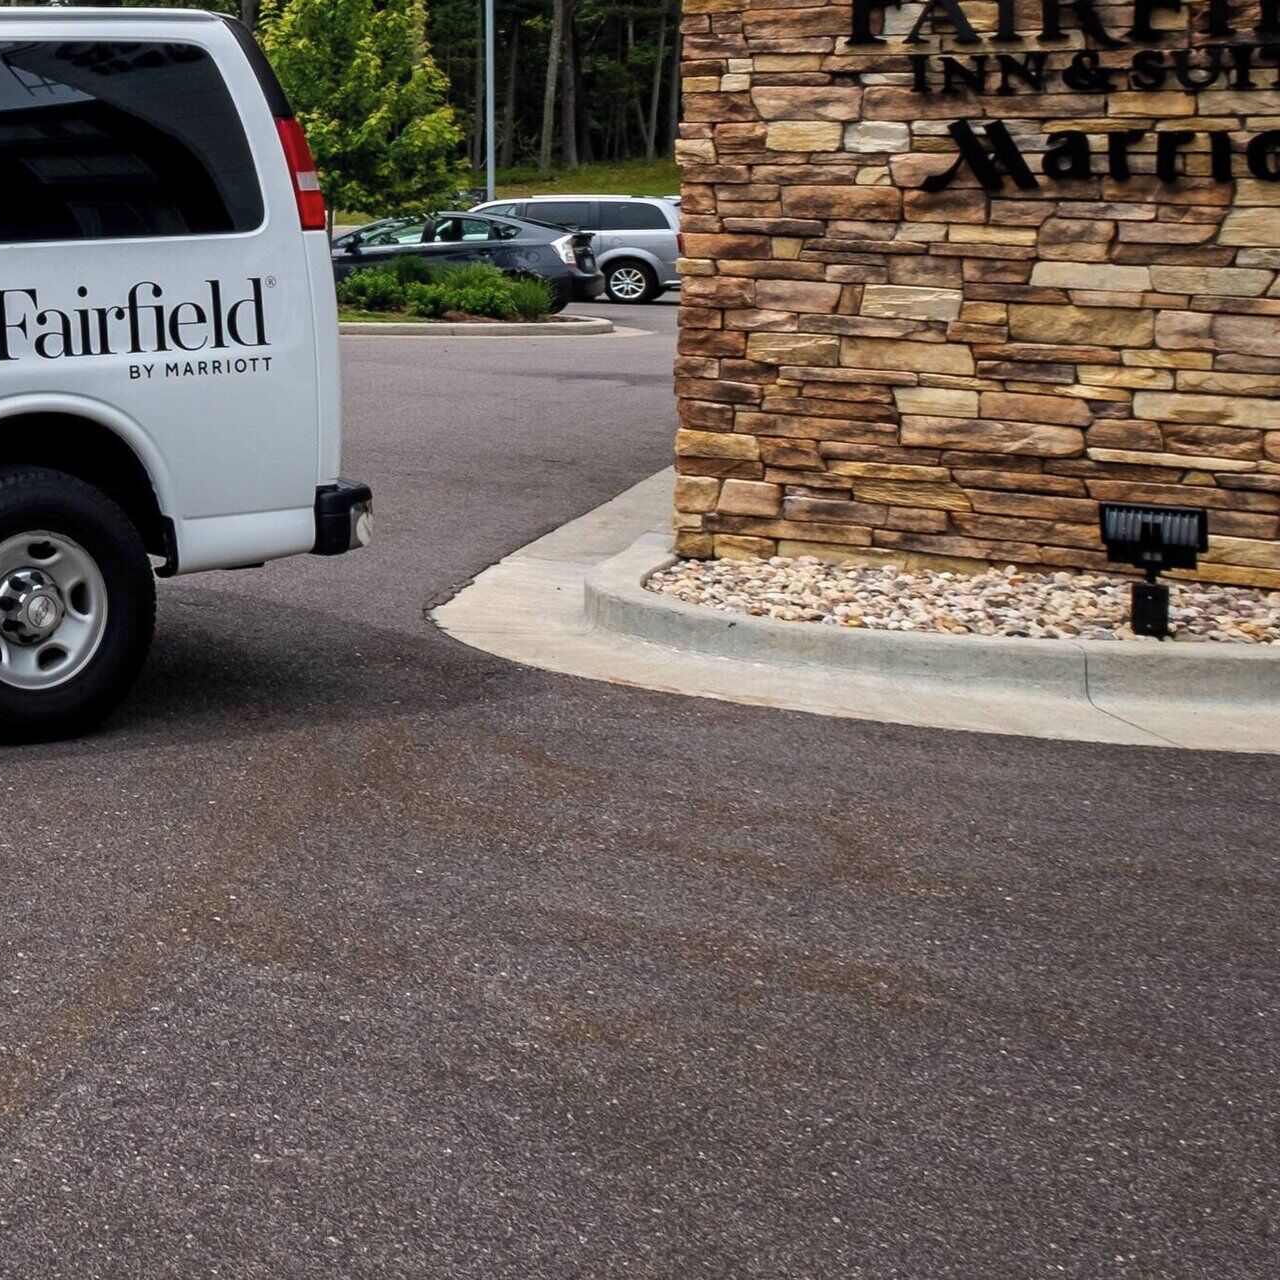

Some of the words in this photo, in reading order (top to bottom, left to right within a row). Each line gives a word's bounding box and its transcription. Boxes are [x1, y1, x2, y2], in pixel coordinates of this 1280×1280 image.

[908, 53, 1047, 95] INN
[1062, 50, 1117, 91] &
[129, 363, 155, 380] BY
[165, 356, 273, 378] MARRIOTT
